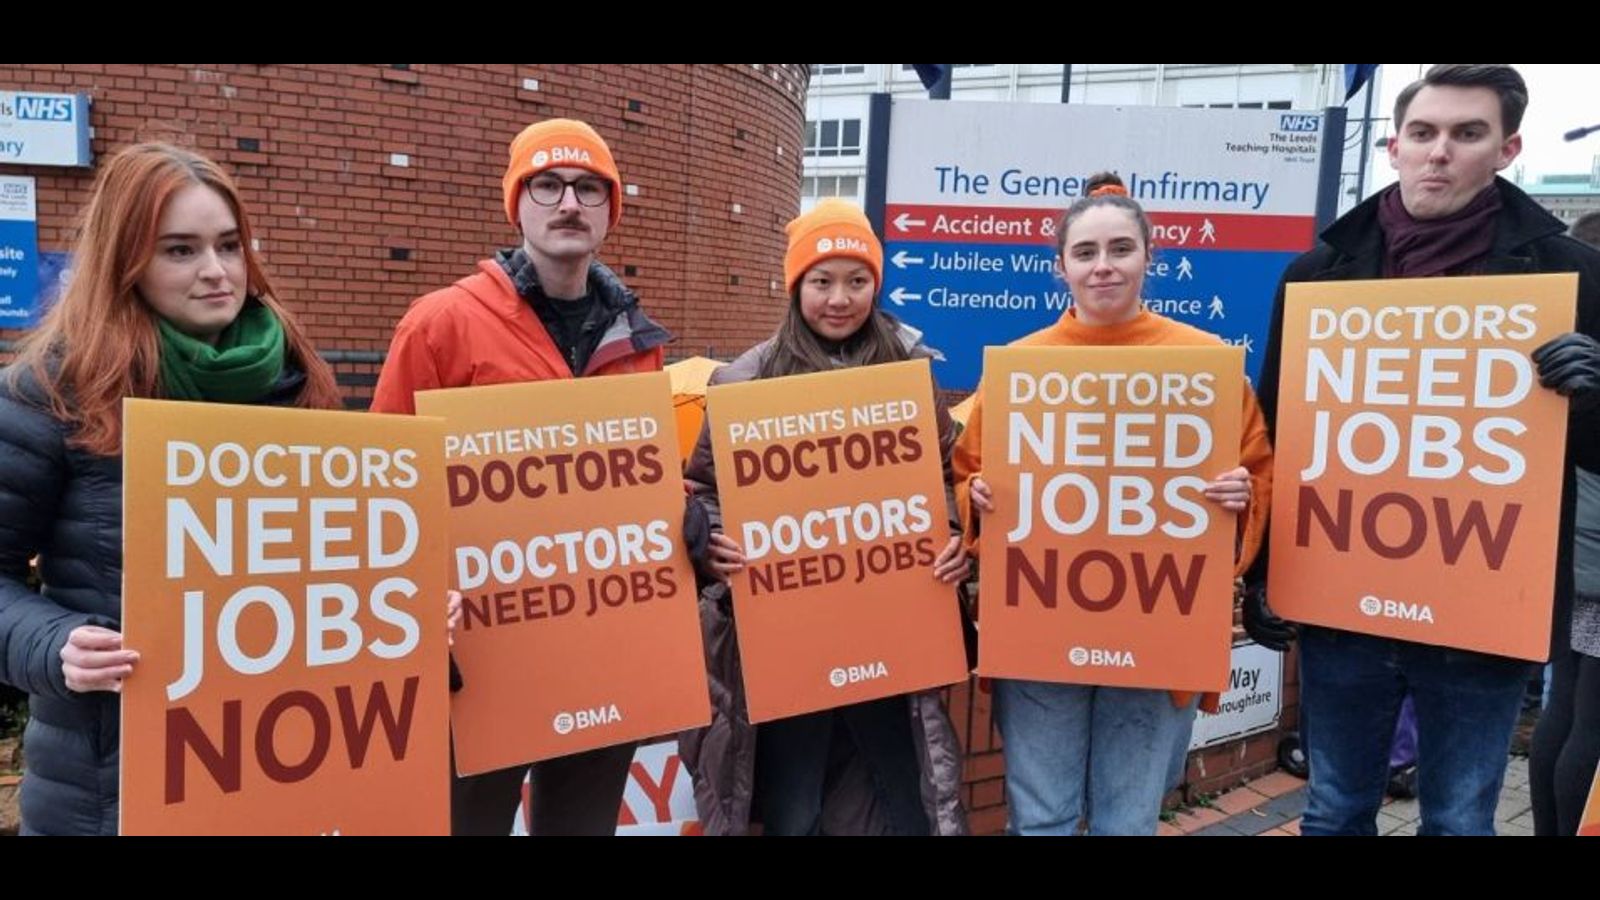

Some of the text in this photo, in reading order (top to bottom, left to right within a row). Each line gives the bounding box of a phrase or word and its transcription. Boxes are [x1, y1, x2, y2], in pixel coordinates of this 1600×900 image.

[17, 97, 70, 119] NHS
[1281, 115, 1317, 130] NHS
[551, 146, 592, 164] BMA
[1225, 142, 1316, 154] Teaching Hospitals
[1270, 133, 1317, 143] The Leeds
[935, 166, 1270, 210] The Gener Infirmary
[834, 236, 869, 253] BMA
[932, 214, 1057, 237] Accident &
[929, 252, 1054, 274] Jubilee Win
[927, 286, 1036, 310] Clarendon
[1309, 303, 1538, 341] DOCTORS
[1009, 371, 1216, 407] DOCTORS
[1305, 347, 1534, 409] NEED
[445, 417, 658, 459] PATIENTS NEED
[729, 400, 918, 444] PATIENTS NEED
[1008, 412, 1214, 469] NEED
[166, 440, 419, 488] DOCTORS
[732, 425, 923, 487] DOCTORS
[1301, 410, 1528, 486] JOBS
[446, 444, 664, 507] DOCTORS
[742, 494, 932, 560] DOCTORS
[1006, 472, 1210, 543] JOBS
[1295, 485, 1523, 571] NOW
[166, 498, 420, 578] NEED
[456, 520, 673, 590] DOCTORS
[750, 537, 937, 596] NEED JOBS
[1005, 546, 1207, 616] NOW
[462, 566, 678, 632] NEED JOBS
[1383, 600, 1434, 624] BMA
[167, 577, 421, 701] JOBS
[1091, 648, 1136, 668] BMA
[849, 661, 889, 683] BMA
[576, 704, 622, 729] BMA
[165, 676, 420, 805] NOW
